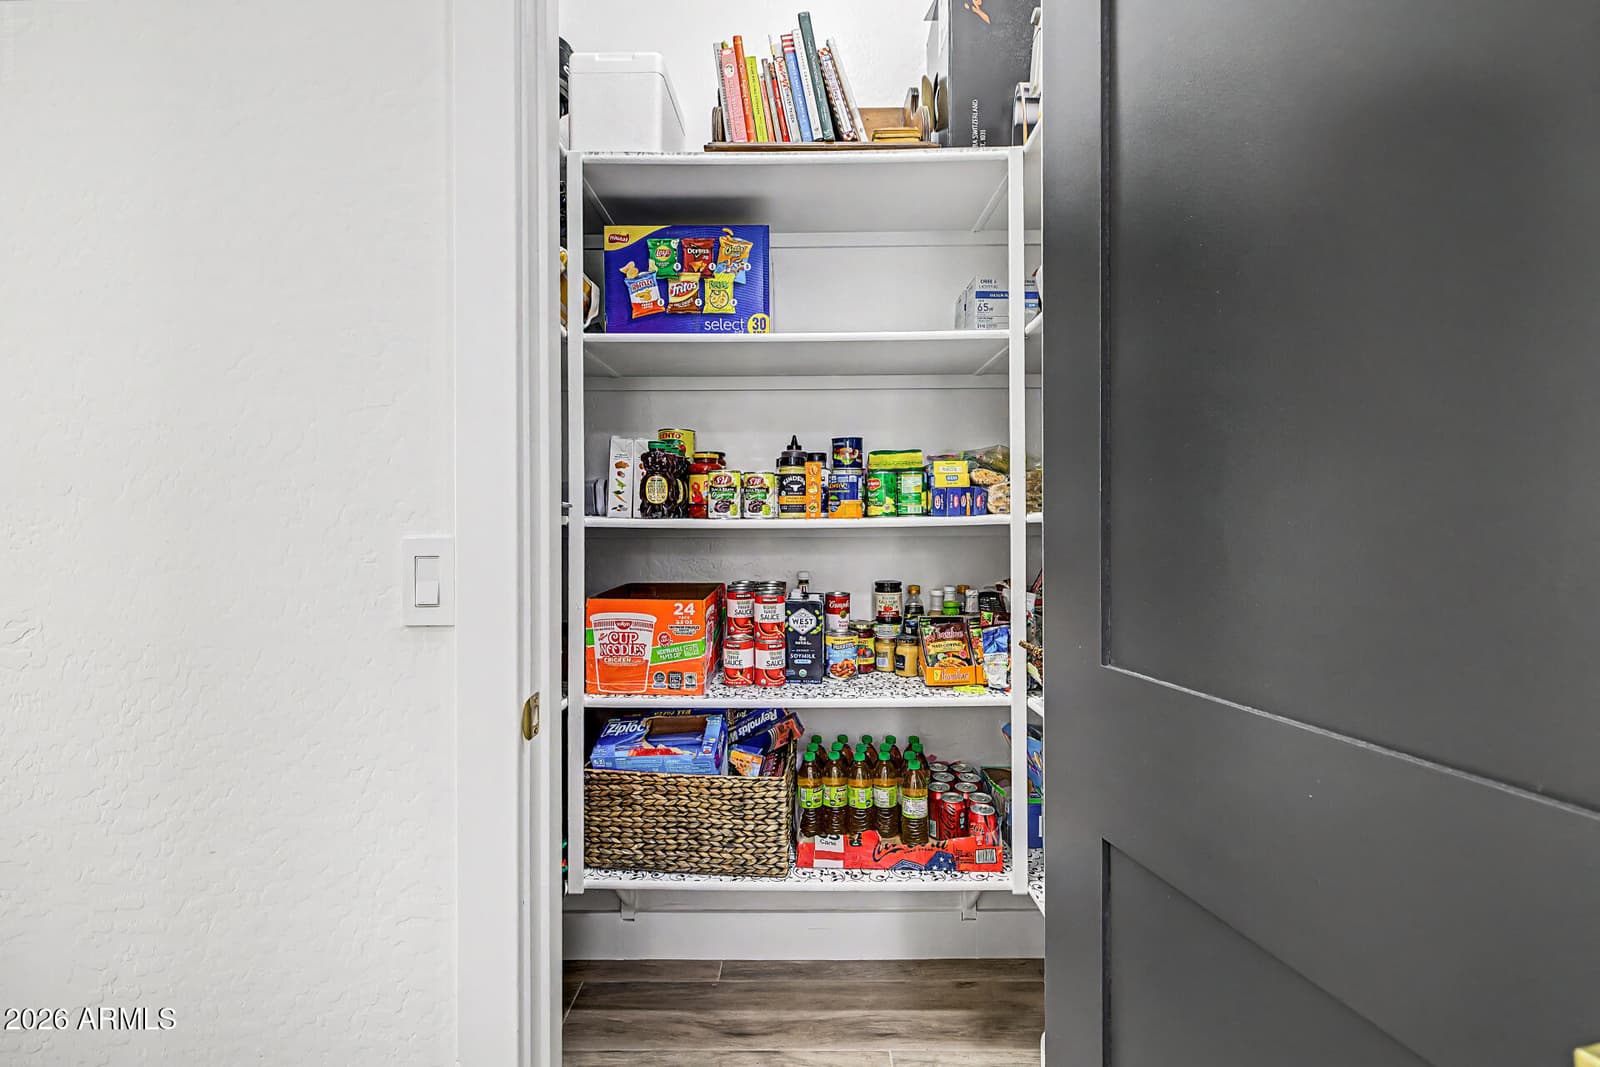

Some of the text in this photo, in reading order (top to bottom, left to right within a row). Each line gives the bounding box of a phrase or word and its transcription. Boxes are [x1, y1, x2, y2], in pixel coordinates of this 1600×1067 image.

[704, 317, 767, 331] select 30
[673, 602, 696, 616] 24
[608, 631, 639, 645] CUP
[599, 643, 647, 657] NOODLES
[606, 720, 646, 736] Ziploc
[737, 708, 778, 737] Reynolds
